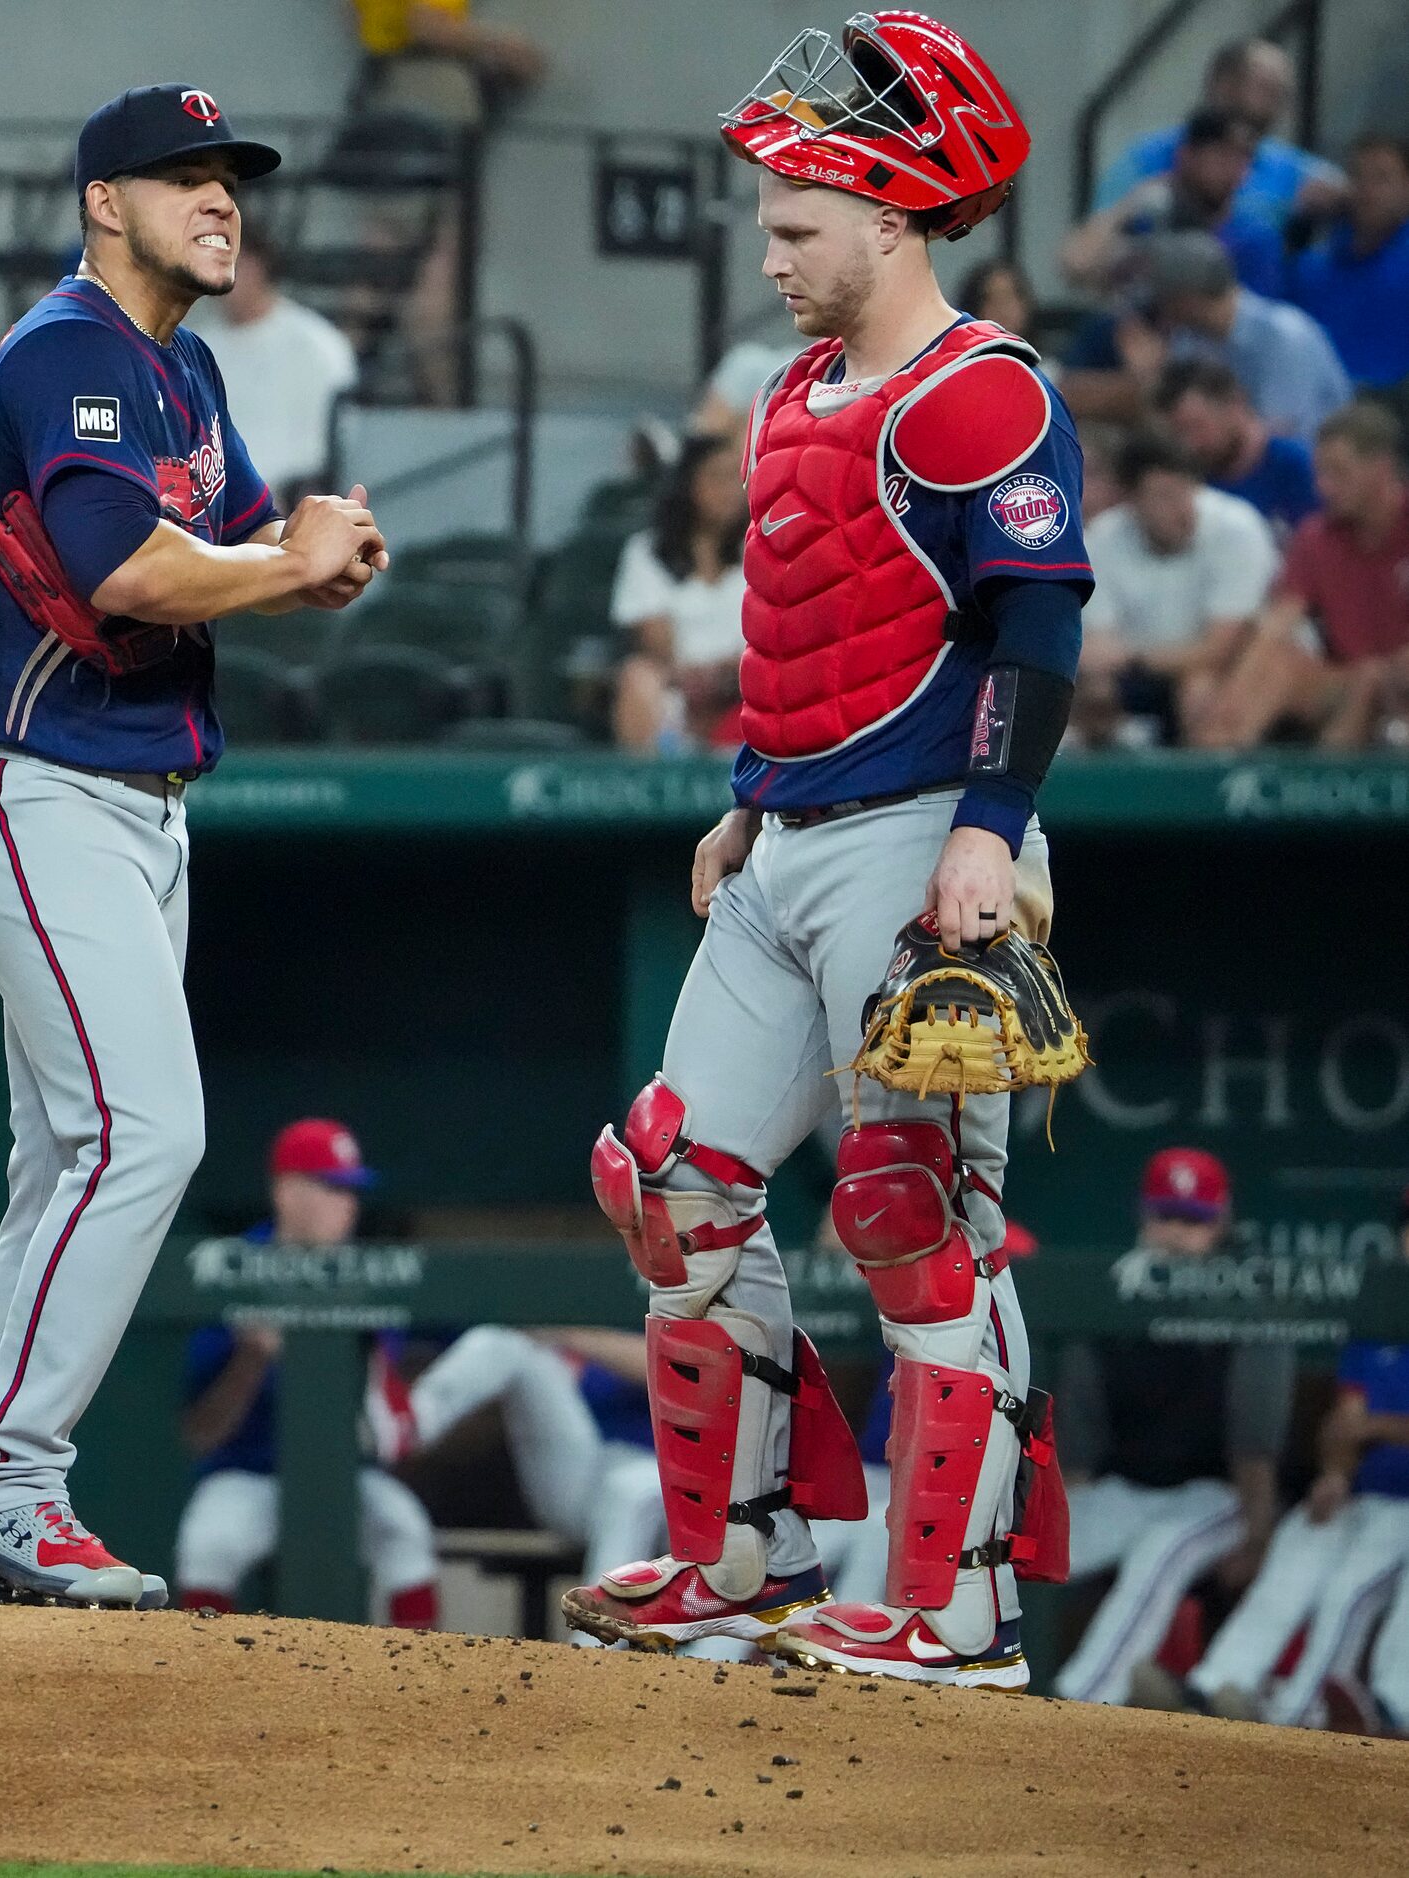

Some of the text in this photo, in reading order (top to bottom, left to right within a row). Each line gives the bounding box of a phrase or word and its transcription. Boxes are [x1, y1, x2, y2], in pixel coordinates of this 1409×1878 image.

[78, 406, 116, 432] MB
[994, 477, 1057, 501] MINNESOTA
[992, 496, 1061, 525] Twins
[1003, 524, 1061, 547] BASEBALL CLUB
